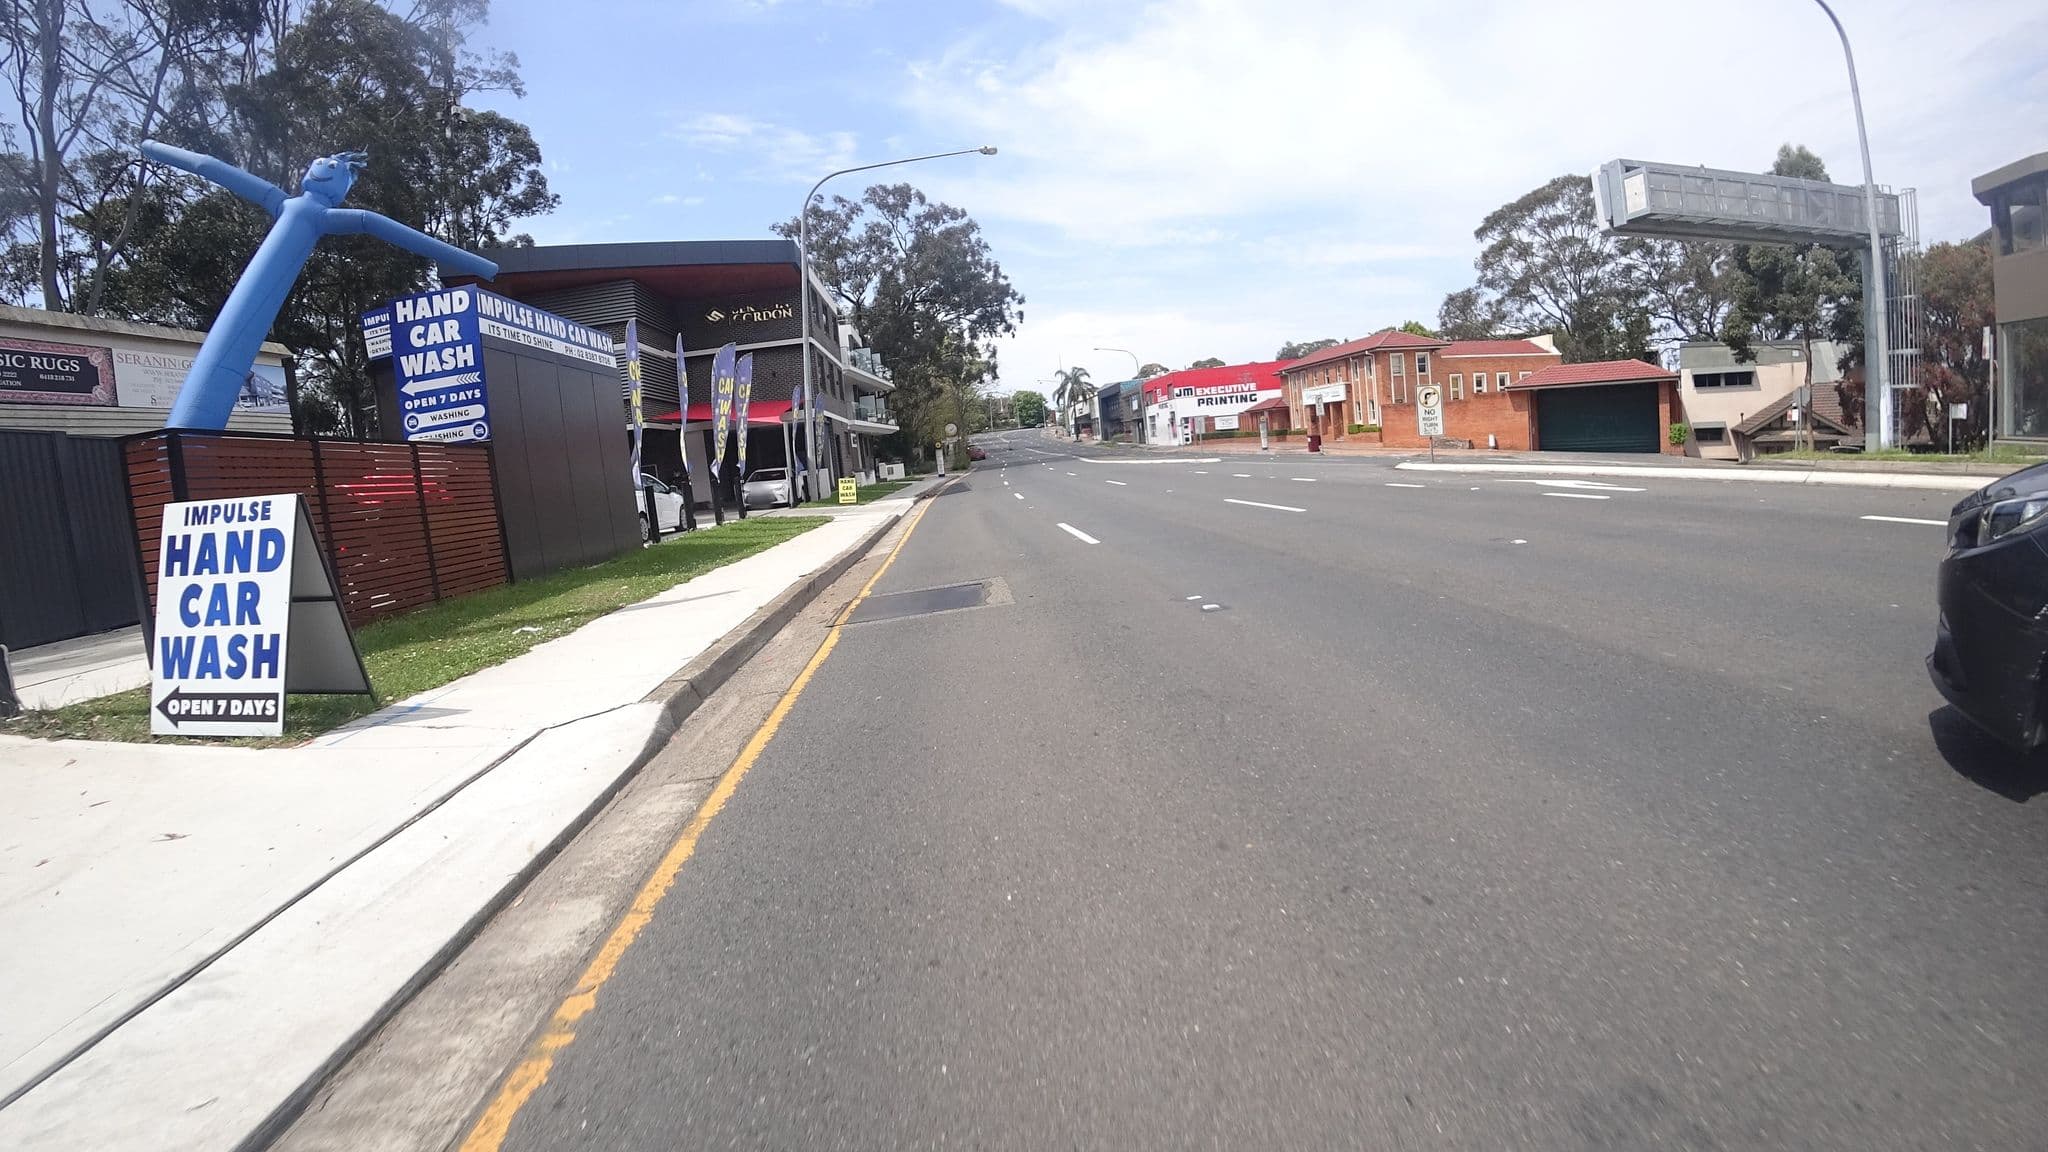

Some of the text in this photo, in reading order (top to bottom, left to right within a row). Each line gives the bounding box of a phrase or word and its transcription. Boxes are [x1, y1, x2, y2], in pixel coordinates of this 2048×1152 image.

[396, 290, 470, 323] HAND
[409, 319, 462, 348] CAR
[476, 292, 614, 353] IMPULSE HAND CAR WASH
[488, 323, 554, 350] ITS TIME TO SHINE
[29, 356, 80, 372] RUGS
[400, 344, 475, 377] WASH
[404, 389, 481, 410] OPEN 7 DAYS
[1196, 382, 1257, 396] EXECUTIVE
[1198, 393, 1257, 407] PRINTING
[430, 409, 470, 422] WASHING
[1424, 408, 1436, 416] NO
[183, 500, 272, 527] IMPULSE
[164, 527, 286, 577] HAND
[179, 580, 261, 628] CAR
[160, 633, 281, 680] WASH
[167, 699, 276, 716] OPEN 7 DAYS
